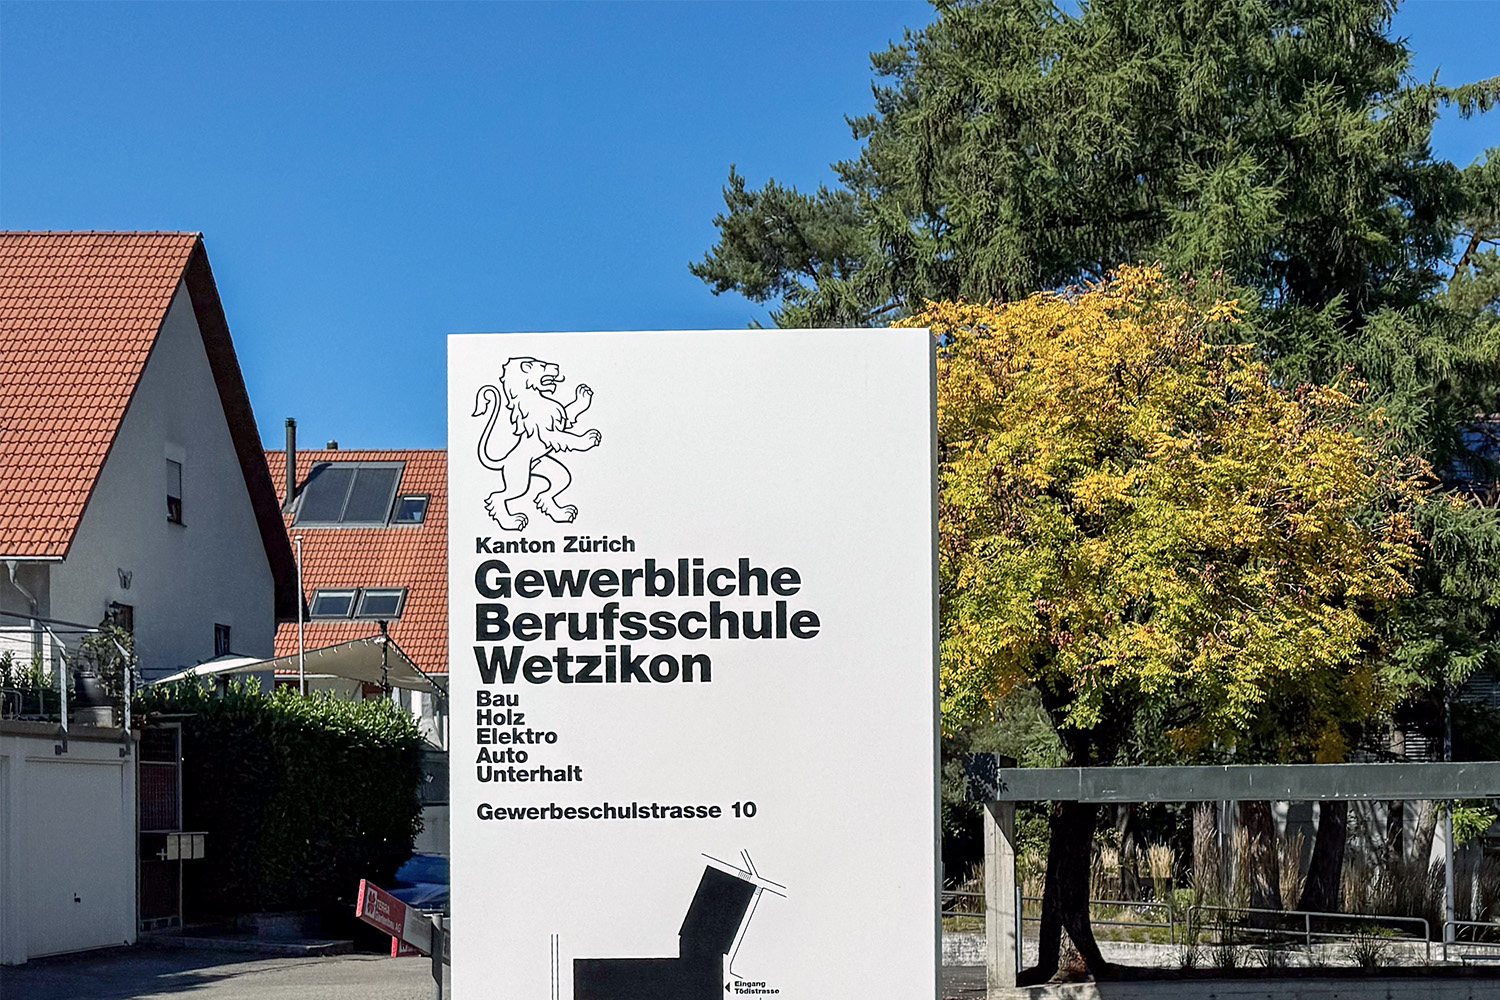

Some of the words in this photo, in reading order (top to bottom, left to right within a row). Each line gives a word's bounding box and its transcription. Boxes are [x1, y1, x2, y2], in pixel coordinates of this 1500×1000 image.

[475, 536, 556, 554] Kanton
[562, 535, 636, 553] Zürich
[474, 557, 802, 600] Gewerbliche
[475, 600, 821, 642] Berufsschule
[472, 644, 713, 685] Wetzikon
[476, 689, 520, 708] Bau
[476, 708, 526, 726] Holz
[476, 727, 558, 745] Elektro
[475, 746, 529, 764] Auto
[476, 764, 583, 783] Unterhalt
[476, 802, 722, 821] Gewerbeschulstrasse
[731, 801, 757, 819] 10
[734, 980, 767, 989] Eingang
[734, 987, 780, 995] Tödistrasse
